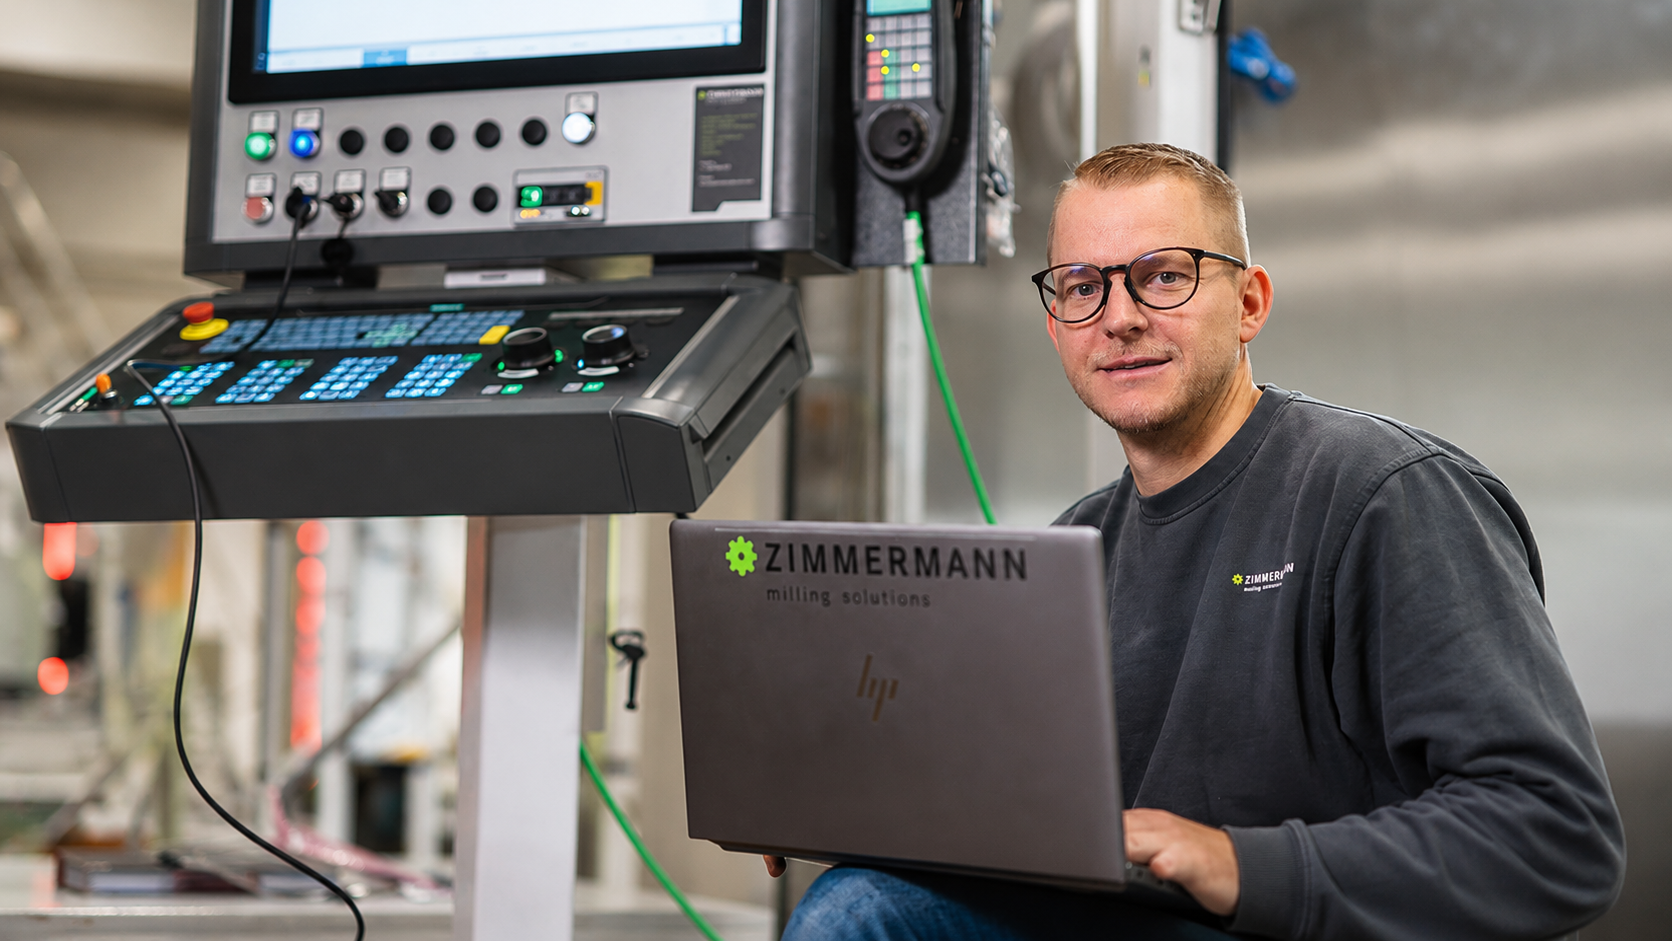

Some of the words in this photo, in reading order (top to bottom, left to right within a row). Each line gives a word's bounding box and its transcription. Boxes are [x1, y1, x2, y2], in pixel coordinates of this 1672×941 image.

[764, 542, 1028, 580] ZIMMERMANN
[766, 585, 832, 607] milling
[842, 588, 932, 608] solutions
